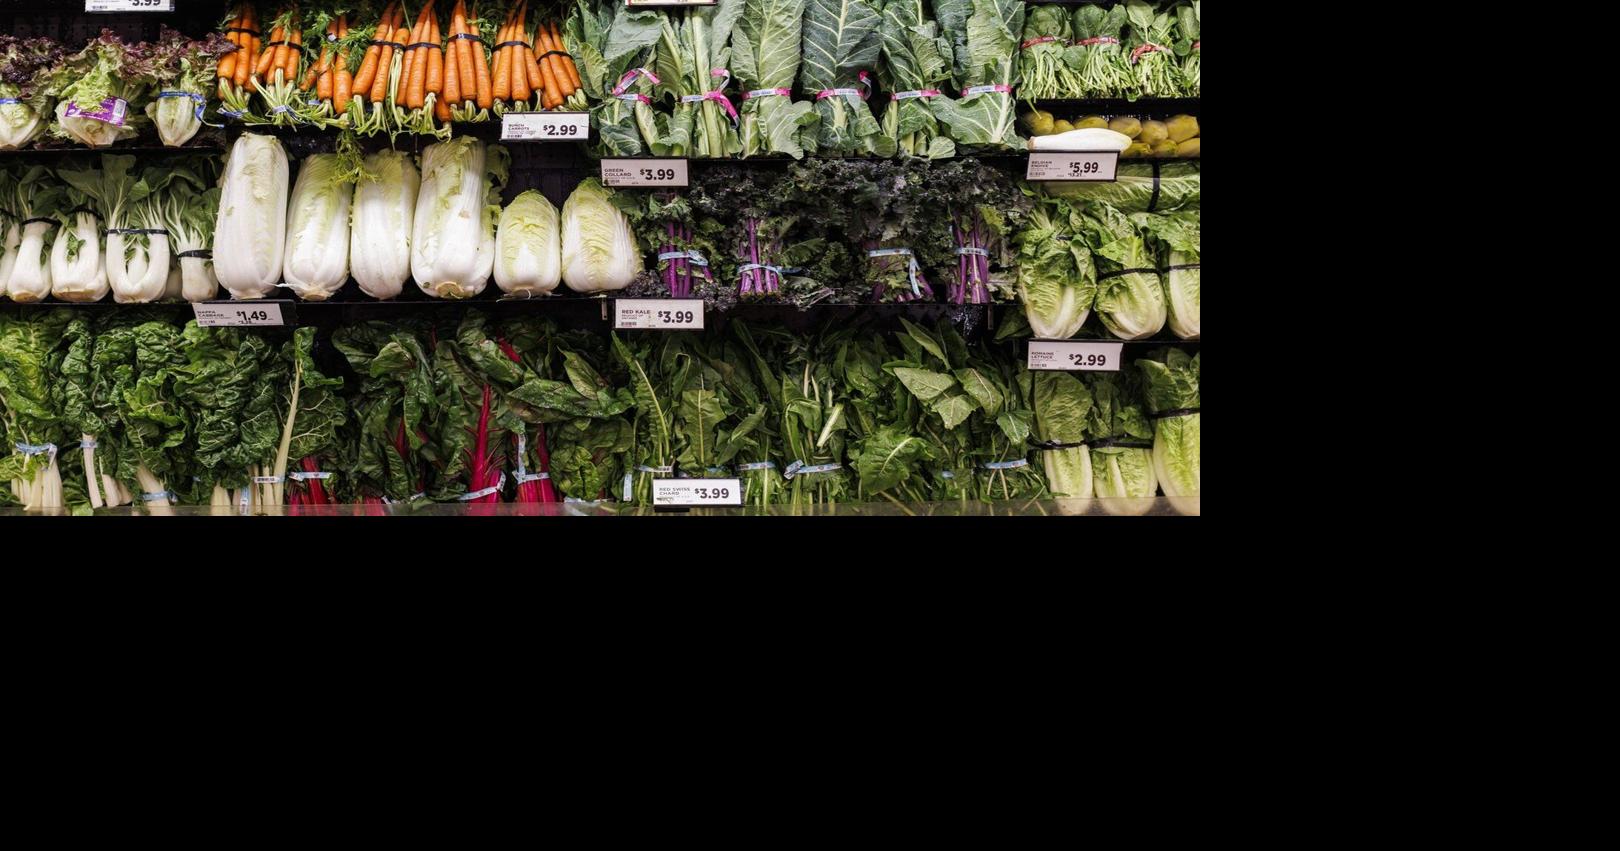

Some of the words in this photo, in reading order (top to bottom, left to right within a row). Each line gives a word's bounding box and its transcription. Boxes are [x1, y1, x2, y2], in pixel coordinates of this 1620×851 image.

[543, 125, 577, 136] $2.99
[1069, 162, 1099, 173] $5.99
[640, 168, 675, 180] $3.99
[236, 310, 268, 320] $1.49
[657, 310, 693, 323] $3.99
[1069, 354, 1106, 366] $2.99
[694, 488, 729, 499] $3.99
